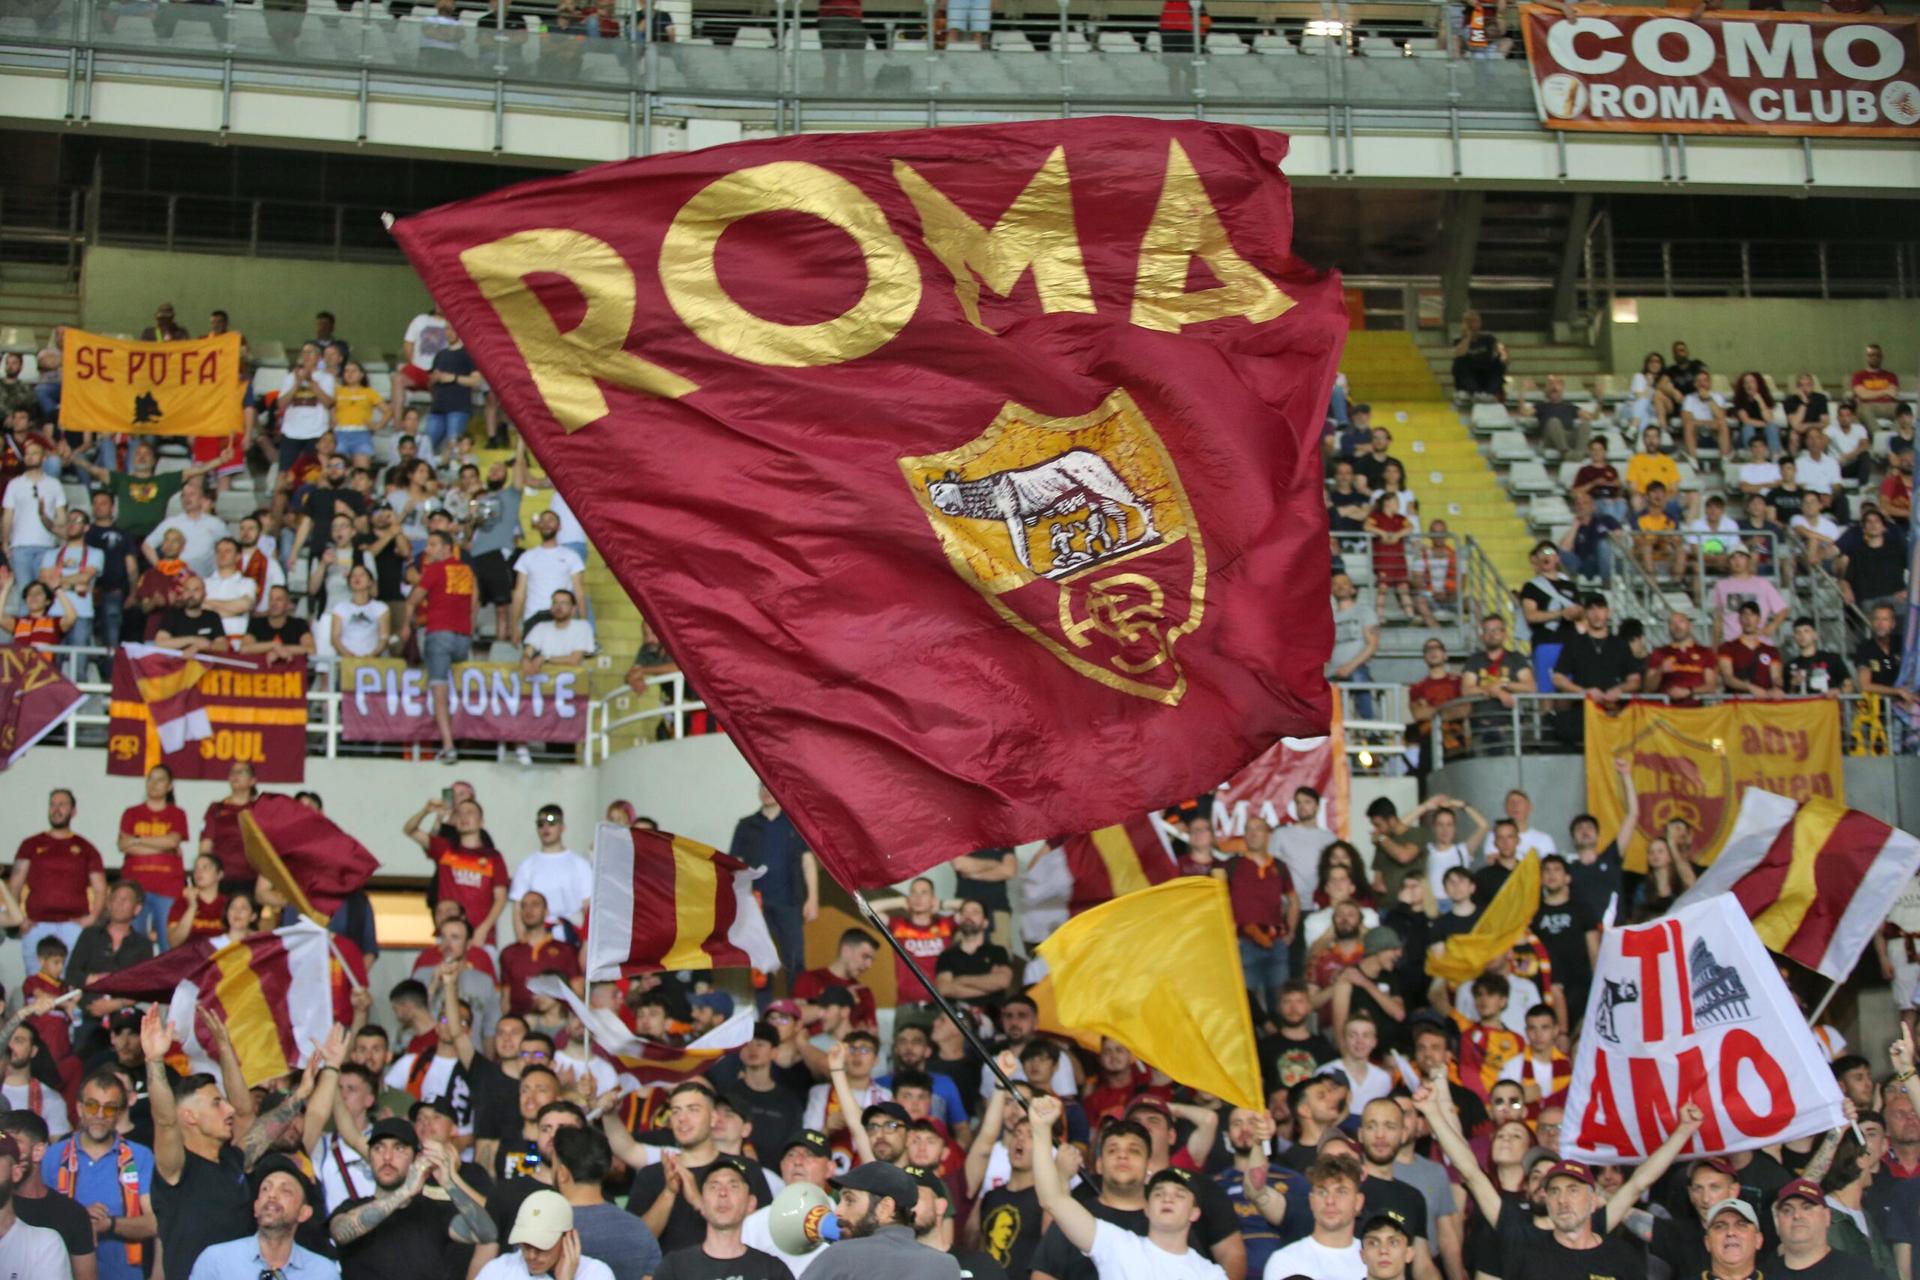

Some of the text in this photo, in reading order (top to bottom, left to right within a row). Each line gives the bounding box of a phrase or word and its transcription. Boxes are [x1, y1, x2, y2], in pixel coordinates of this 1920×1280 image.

[1546, 17, 1905, 81] COMO
[1590, 84, 1735, 121] ROMA
[1749, 89, 1879, 124] CLUB
[460, 136, 1297, 434] ROMA
[77, 346, 114, 381] SE
[201, 670, 302, 698] RTHERN
[200, 729, 266, 763] SOUL
[1740, 724, 1809, 761] any
[1621, 919, 1695, 1042] TI
[1576, 1028, 1796, 1157] AMO
